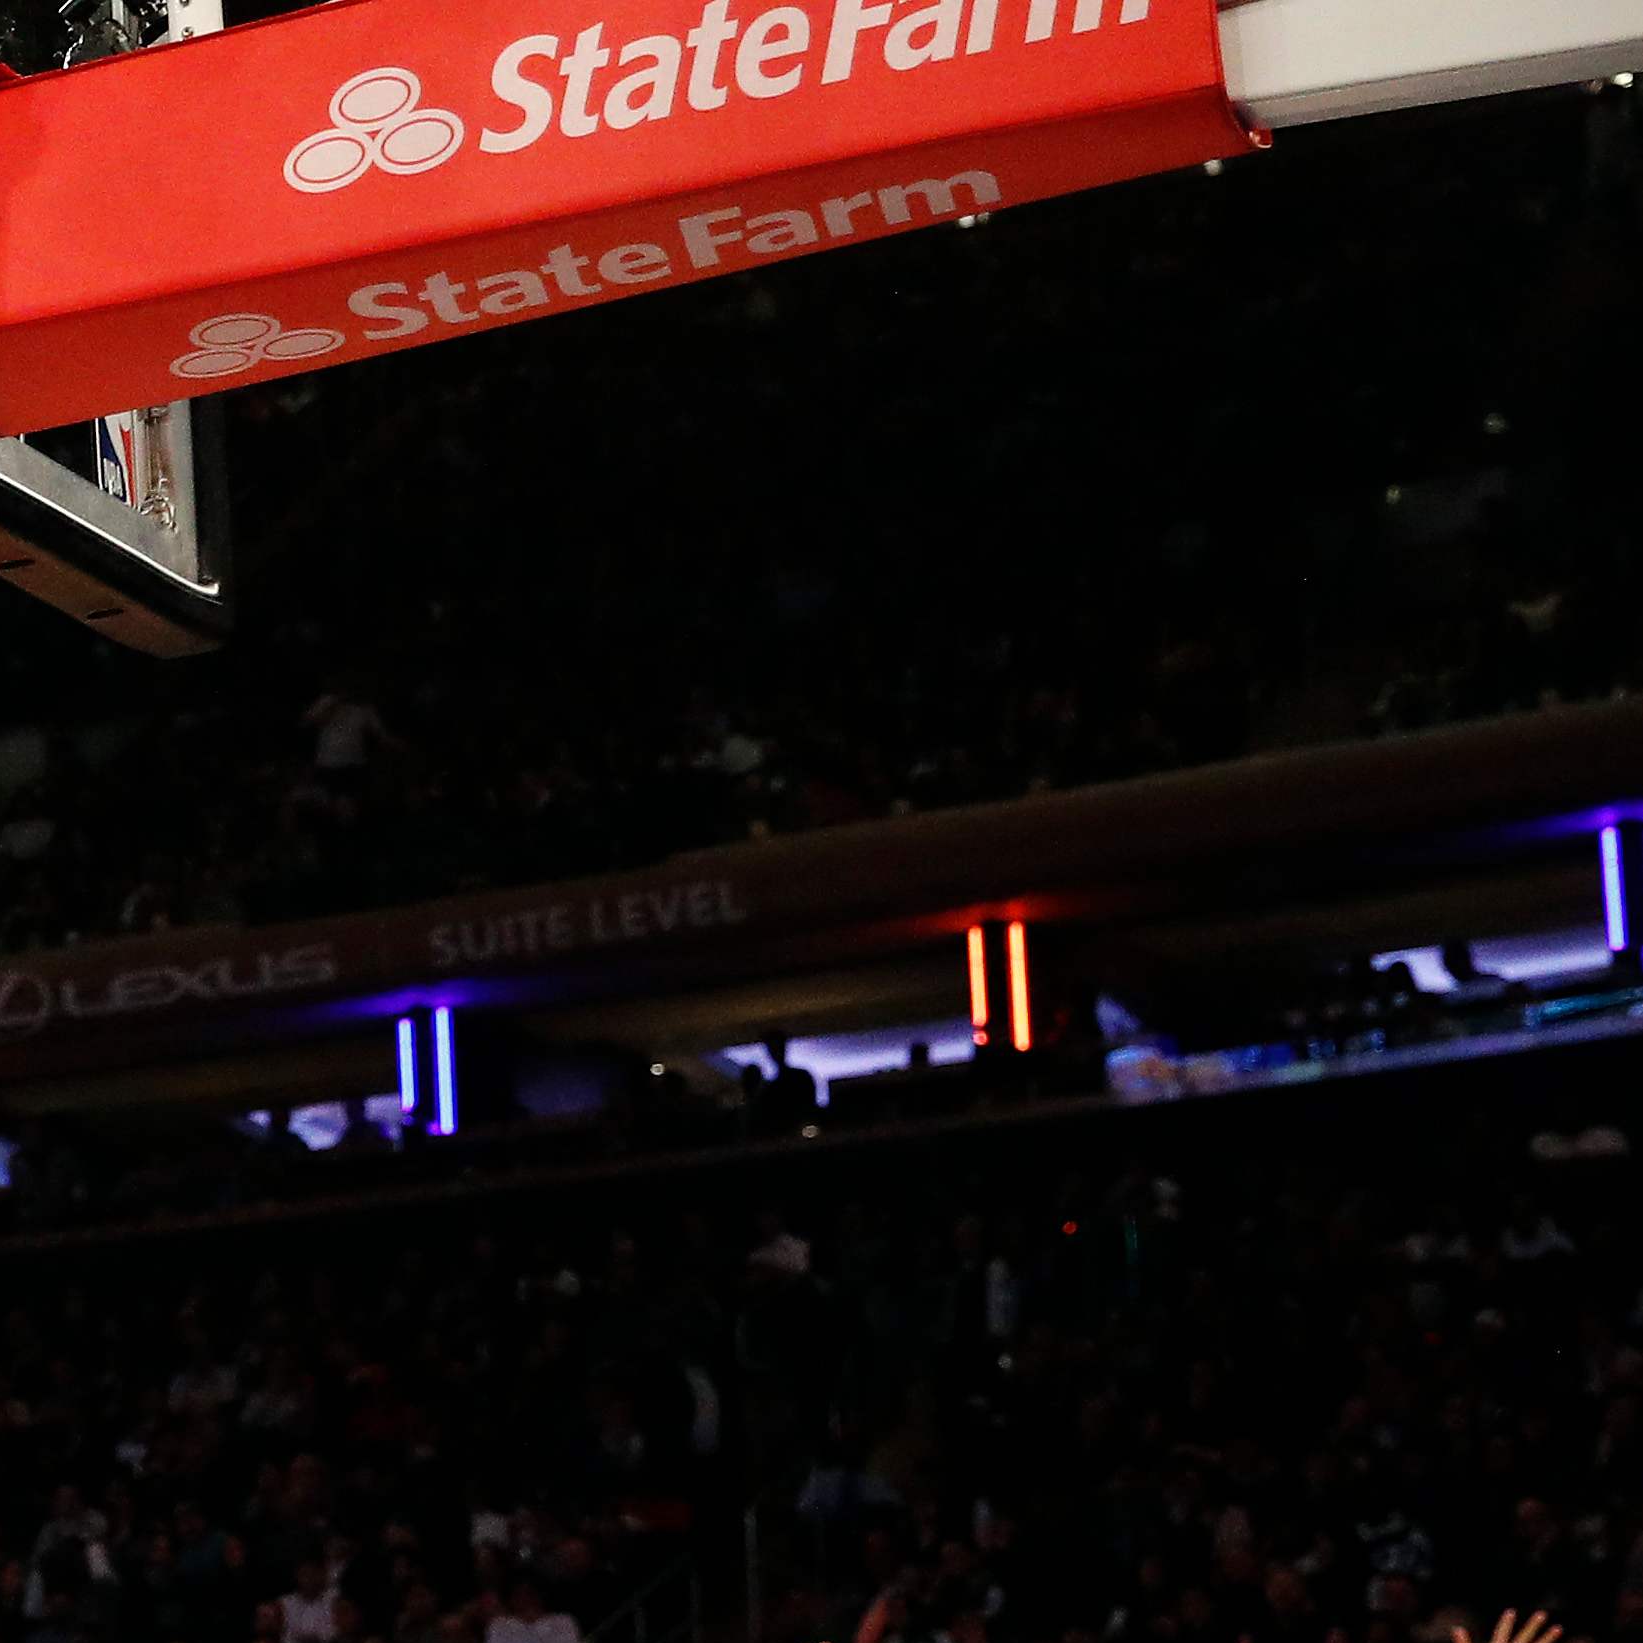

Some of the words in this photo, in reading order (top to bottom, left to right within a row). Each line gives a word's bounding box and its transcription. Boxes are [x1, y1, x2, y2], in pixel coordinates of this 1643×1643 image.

[479, 3, 809, 154] State
[347, 241, 672, 342] State
[678, 168, 1003, 270] Farm
[58, 942, 338, 1019] LEXUS
[425, 904, 573, 968] SUITE
[590, 879, 747, 948] LEVEL
